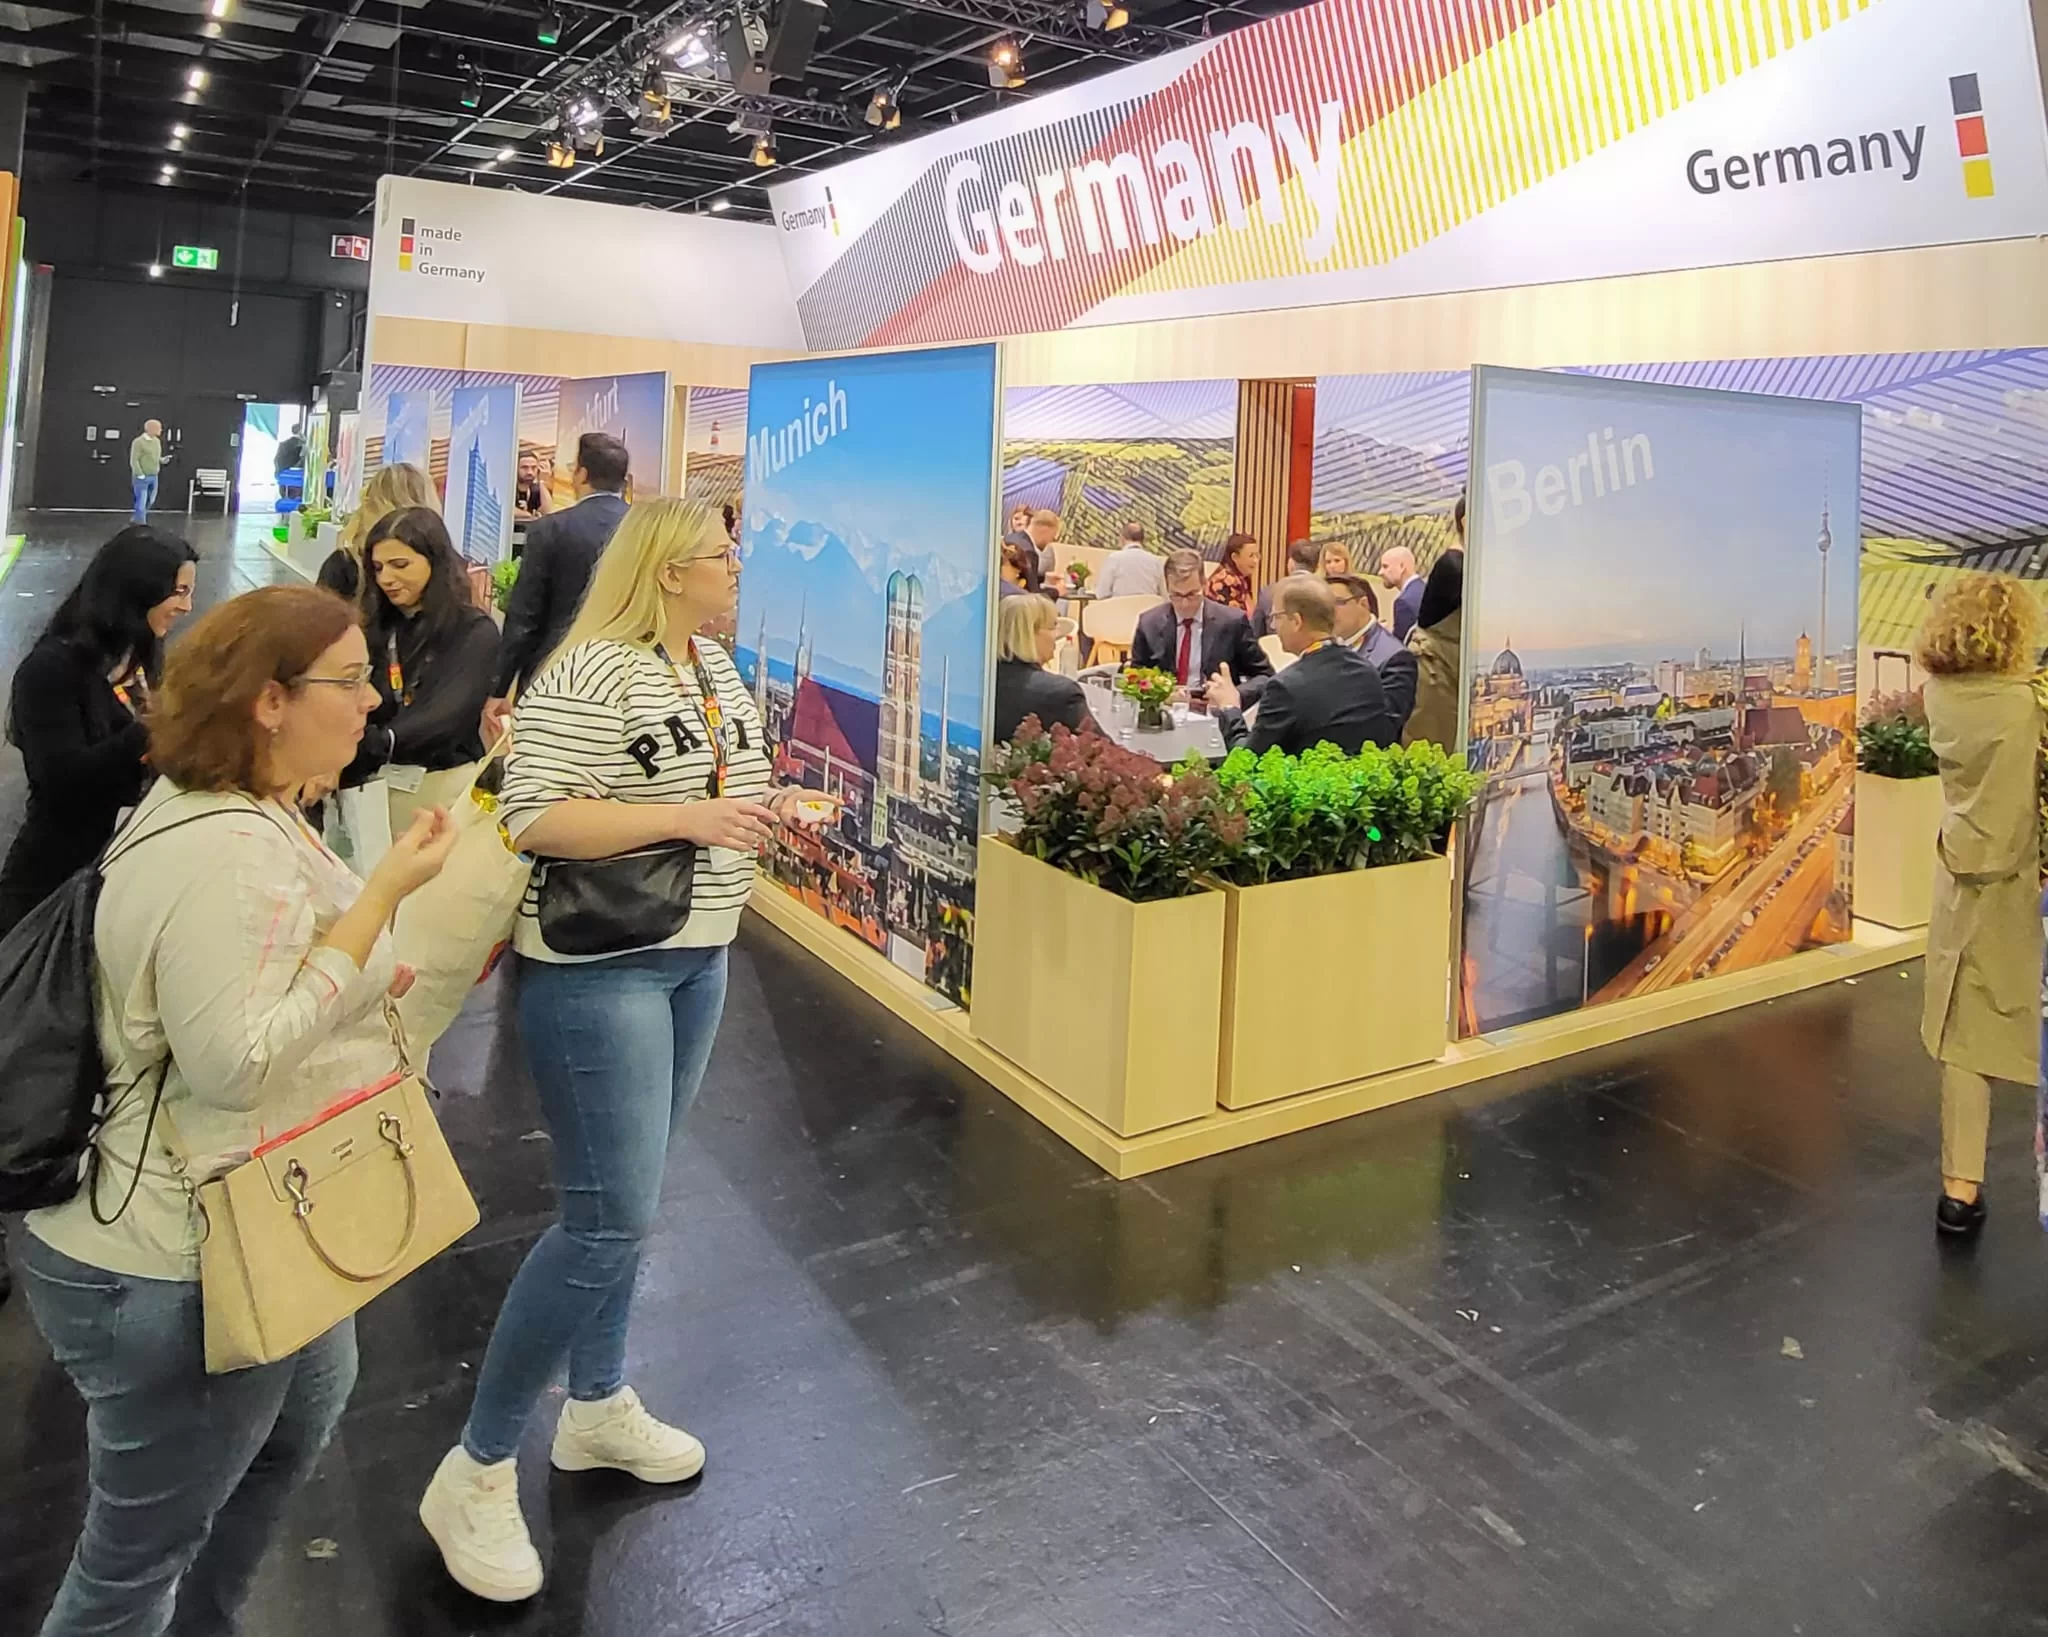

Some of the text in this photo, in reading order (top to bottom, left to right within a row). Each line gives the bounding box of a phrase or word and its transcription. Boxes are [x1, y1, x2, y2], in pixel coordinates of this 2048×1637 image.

[1686, 125, 1926, 195] Germany
[944, 99, 1342, 275] Germany
[420, 227, 462, 242] made
[781, 204, 827, 232] Germany
[418, 262, 485, 283] Germany
[419, 242, 433, 257] in
[748, 379, 848, 484] Munich
[1486, 425, 1656, 535] Berlin
